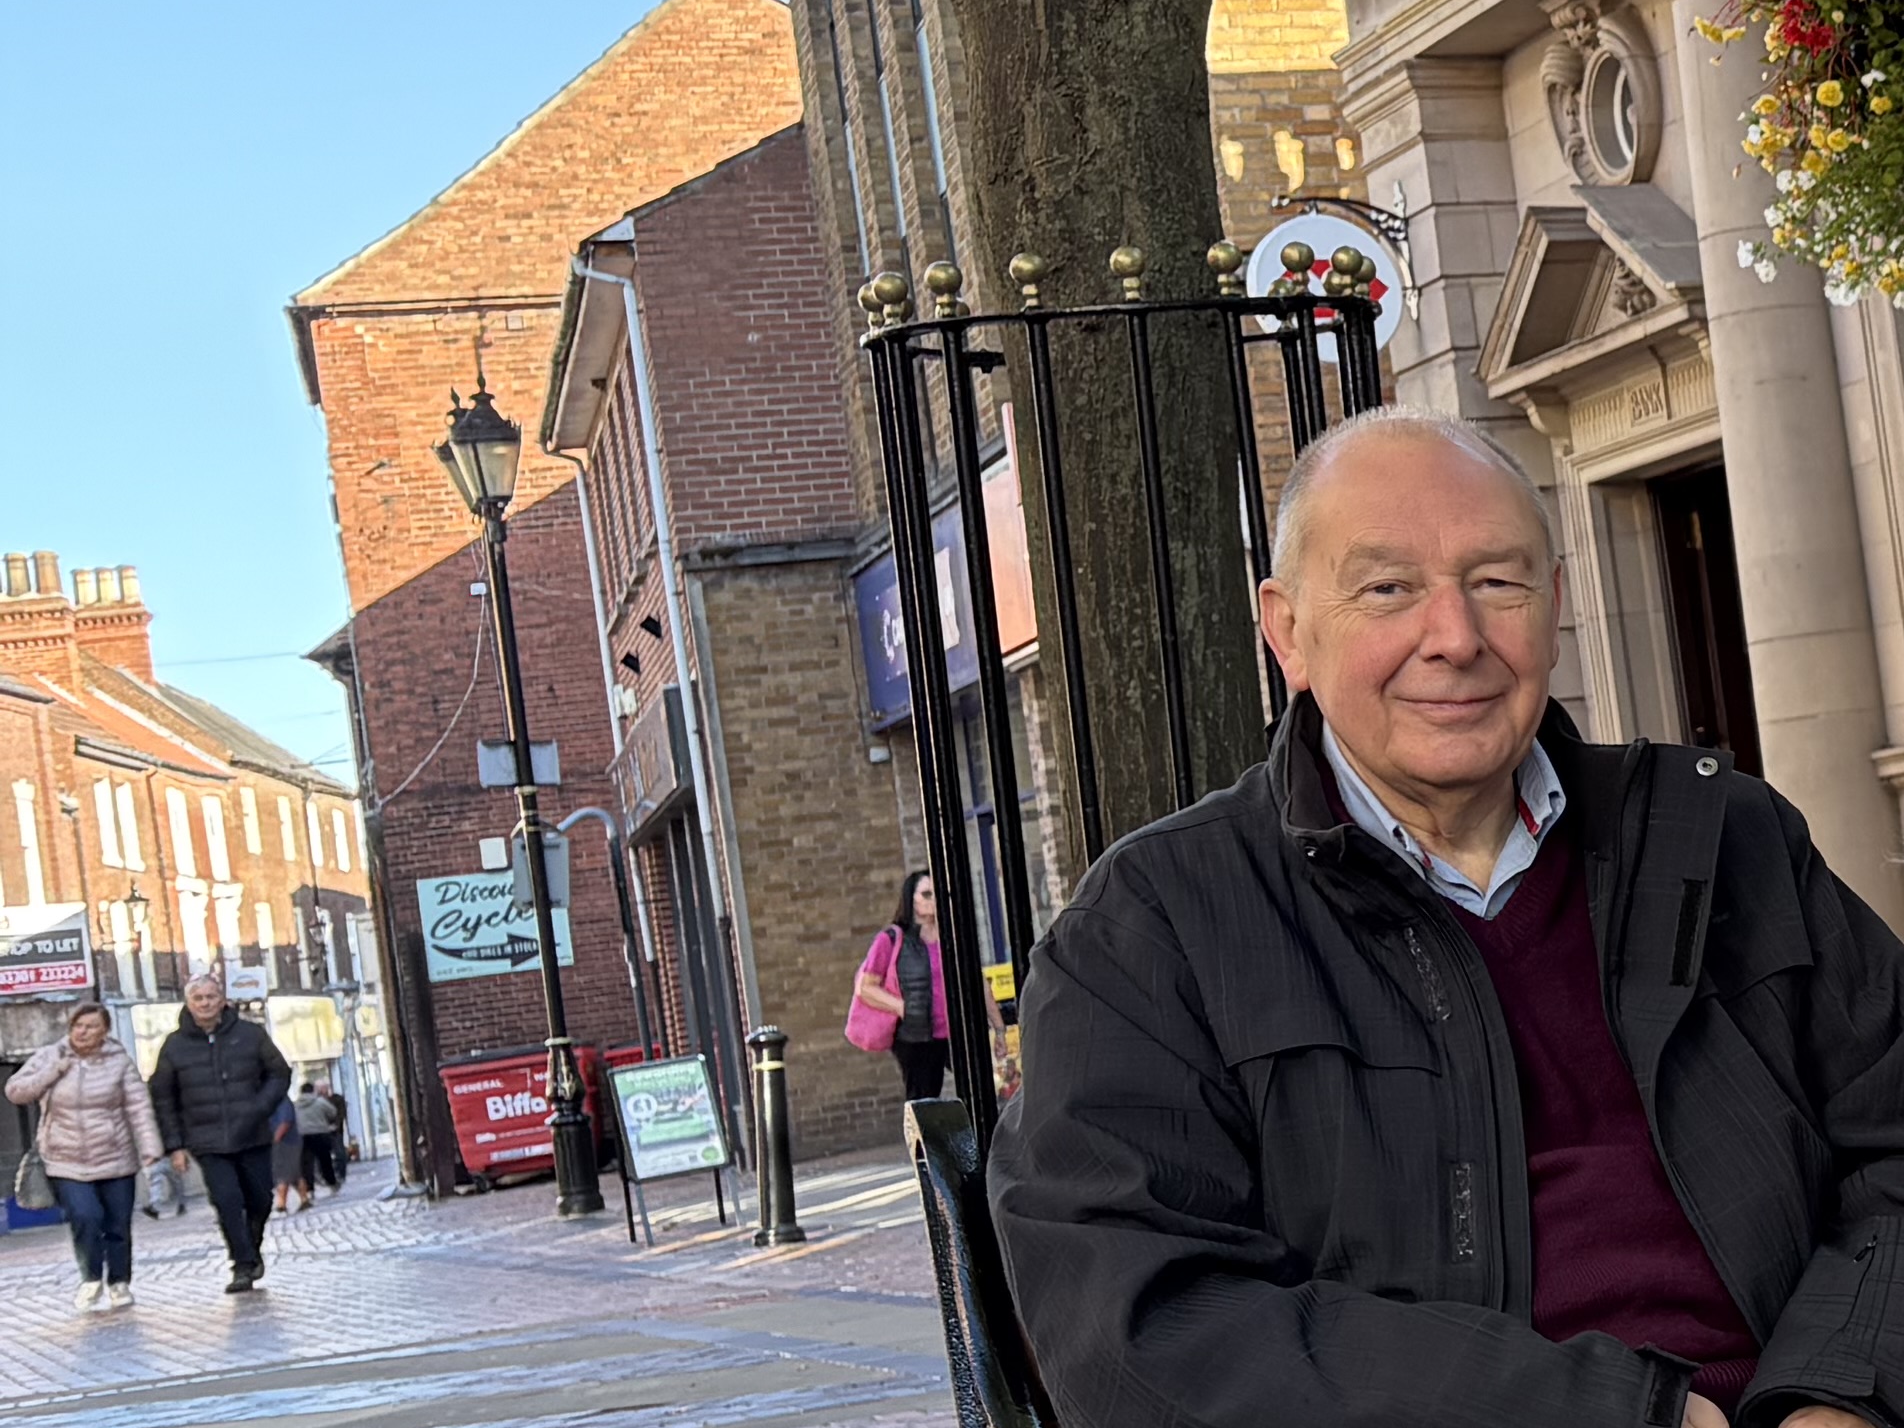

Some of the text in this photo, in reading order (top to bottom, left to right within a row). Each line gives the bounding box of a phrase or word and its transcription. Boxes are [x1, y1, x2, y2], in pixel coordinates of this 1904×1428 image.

[1630, 381, 1664, 421] BANK
[435, 881, 514, 905] Discou
[430, 901, 535, 943] Cycle
[34, 939, 54, 954] TO
[55, 937, 80, 952] LET
[453, 1079, 504, 1095] GENERAL
[486, 1091, 547, 1121] Biffa
